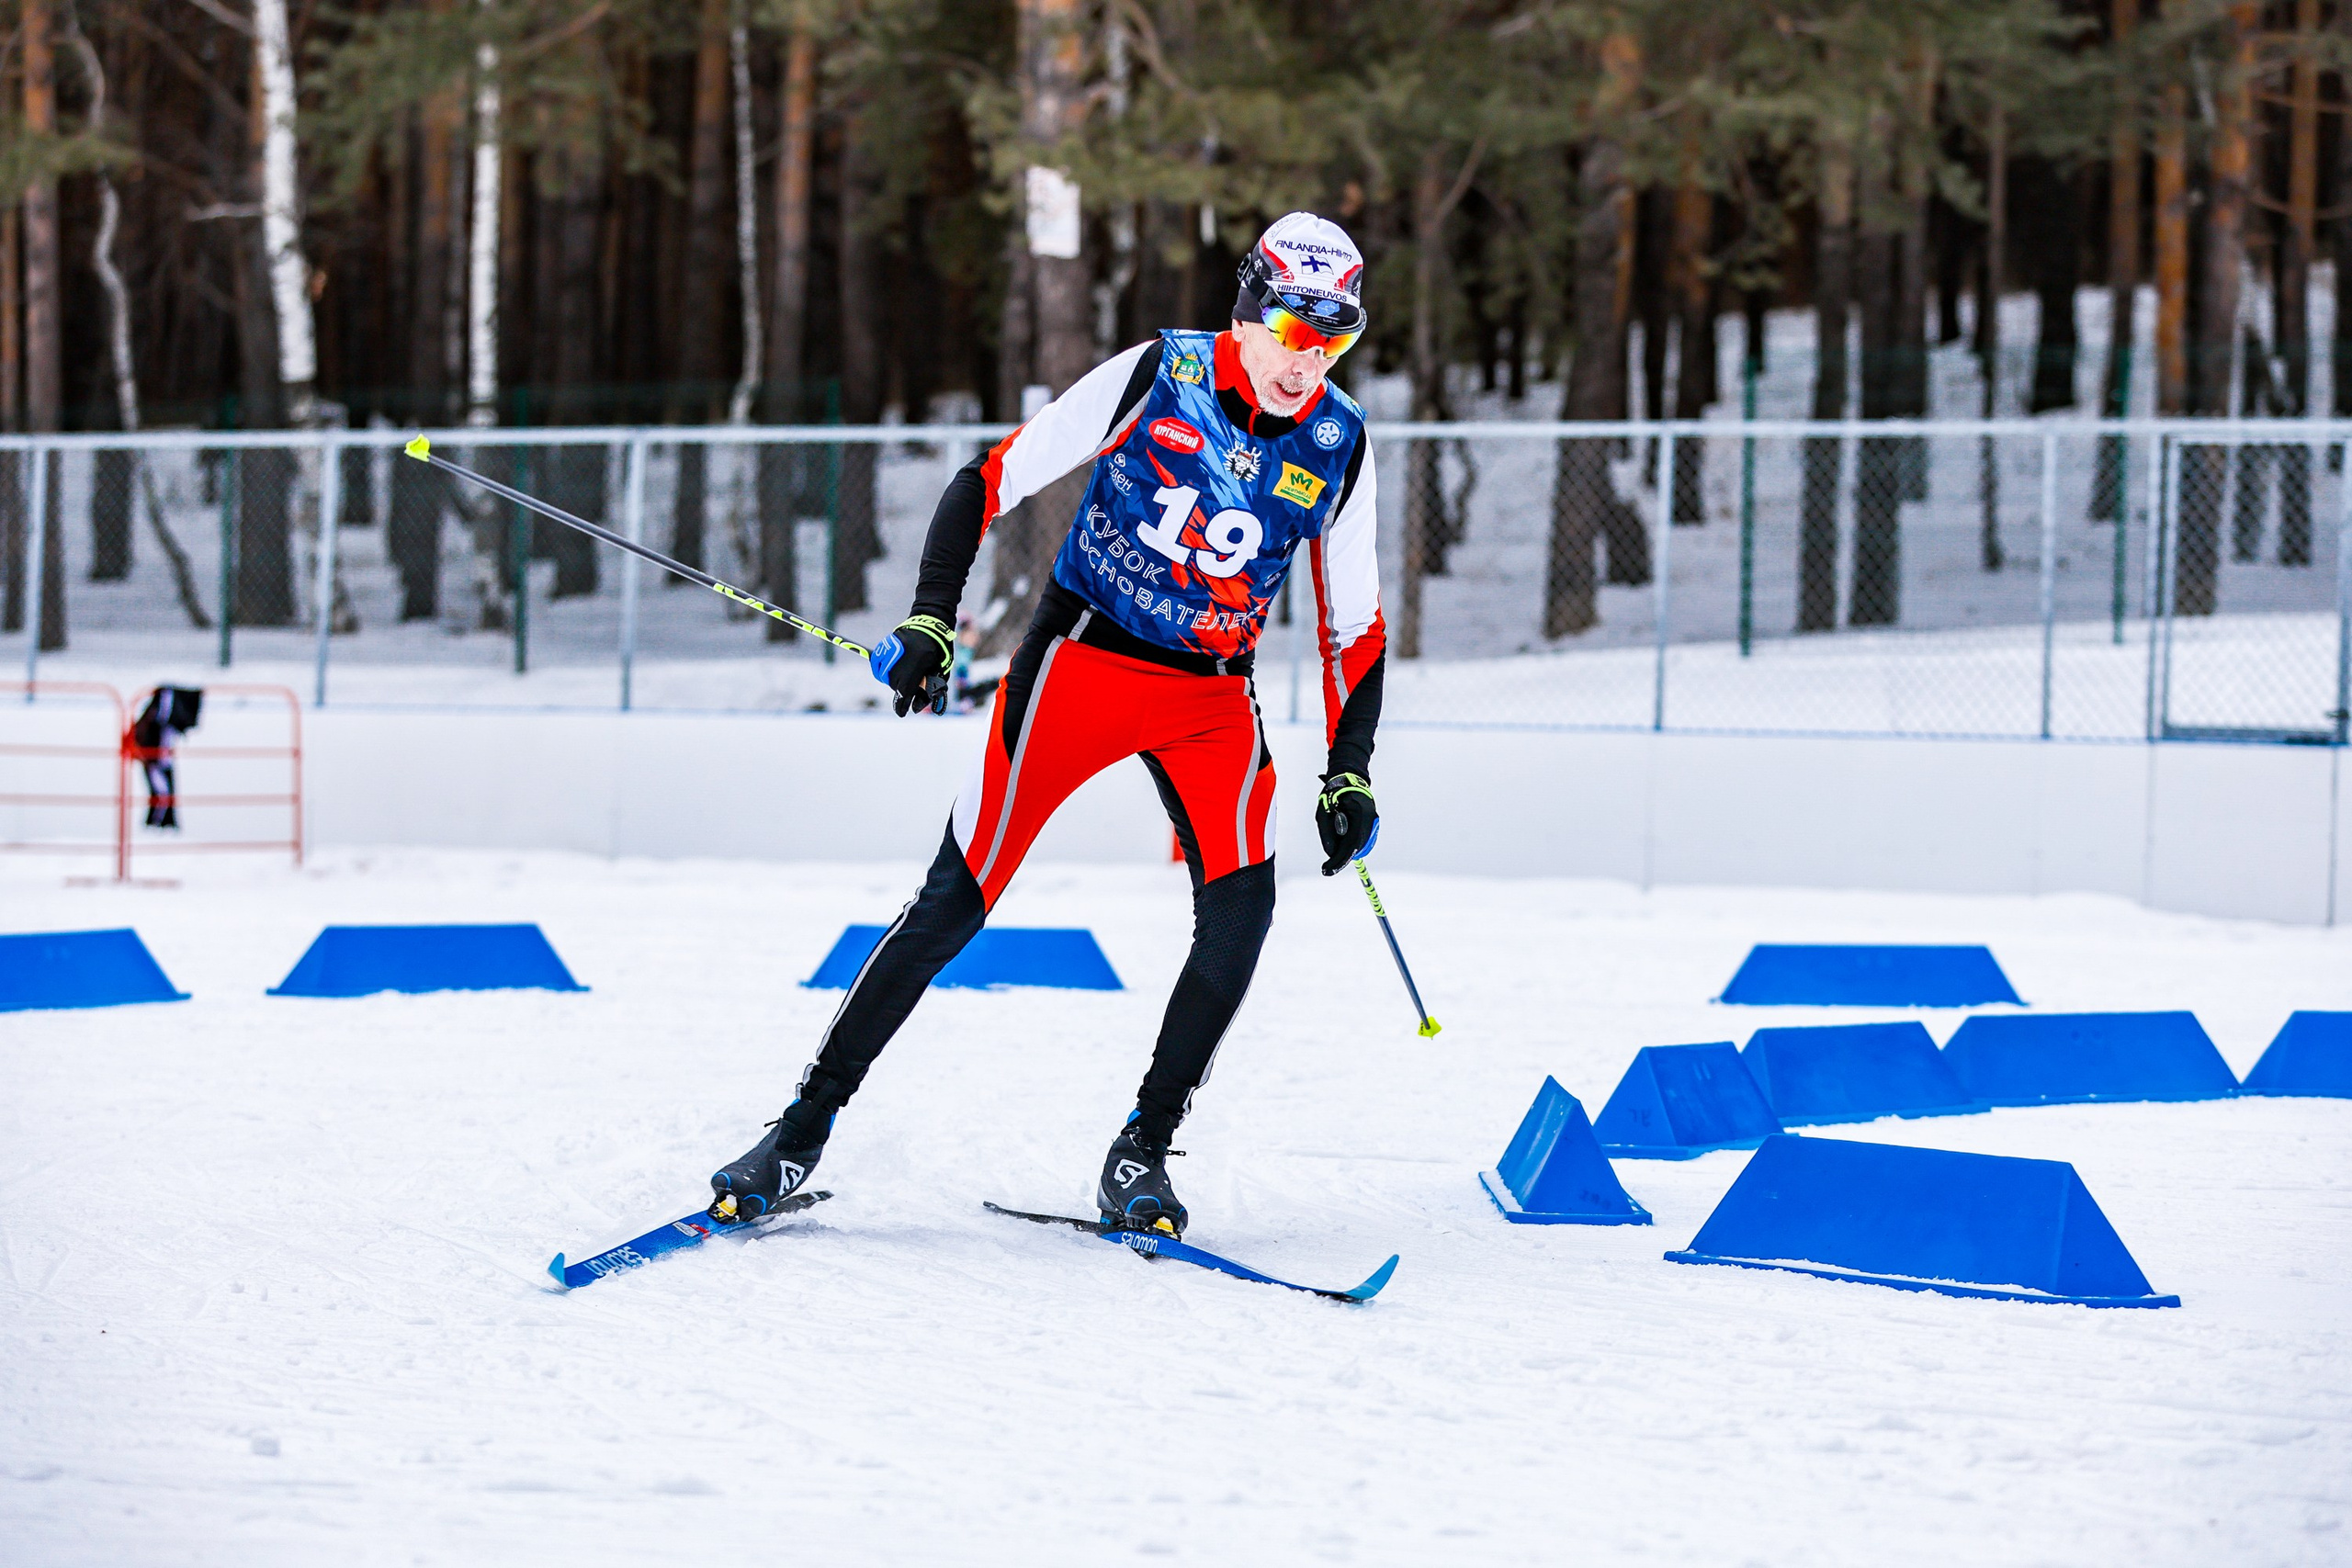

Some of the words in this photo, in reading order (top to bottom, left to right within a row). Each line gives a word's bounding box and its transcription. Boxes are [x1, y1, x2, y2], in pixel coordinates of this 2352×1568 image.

[1277, 284, 1348, 303] HIIHTONEUVOS
[1153, 423, 1200, 449] КУРГАНСКИЙ
[1086, 503, 1166, 585] КУБОК
[1136, 484, 1264, 579] 19
[1121, 1232, 1159, 1254] salomon
